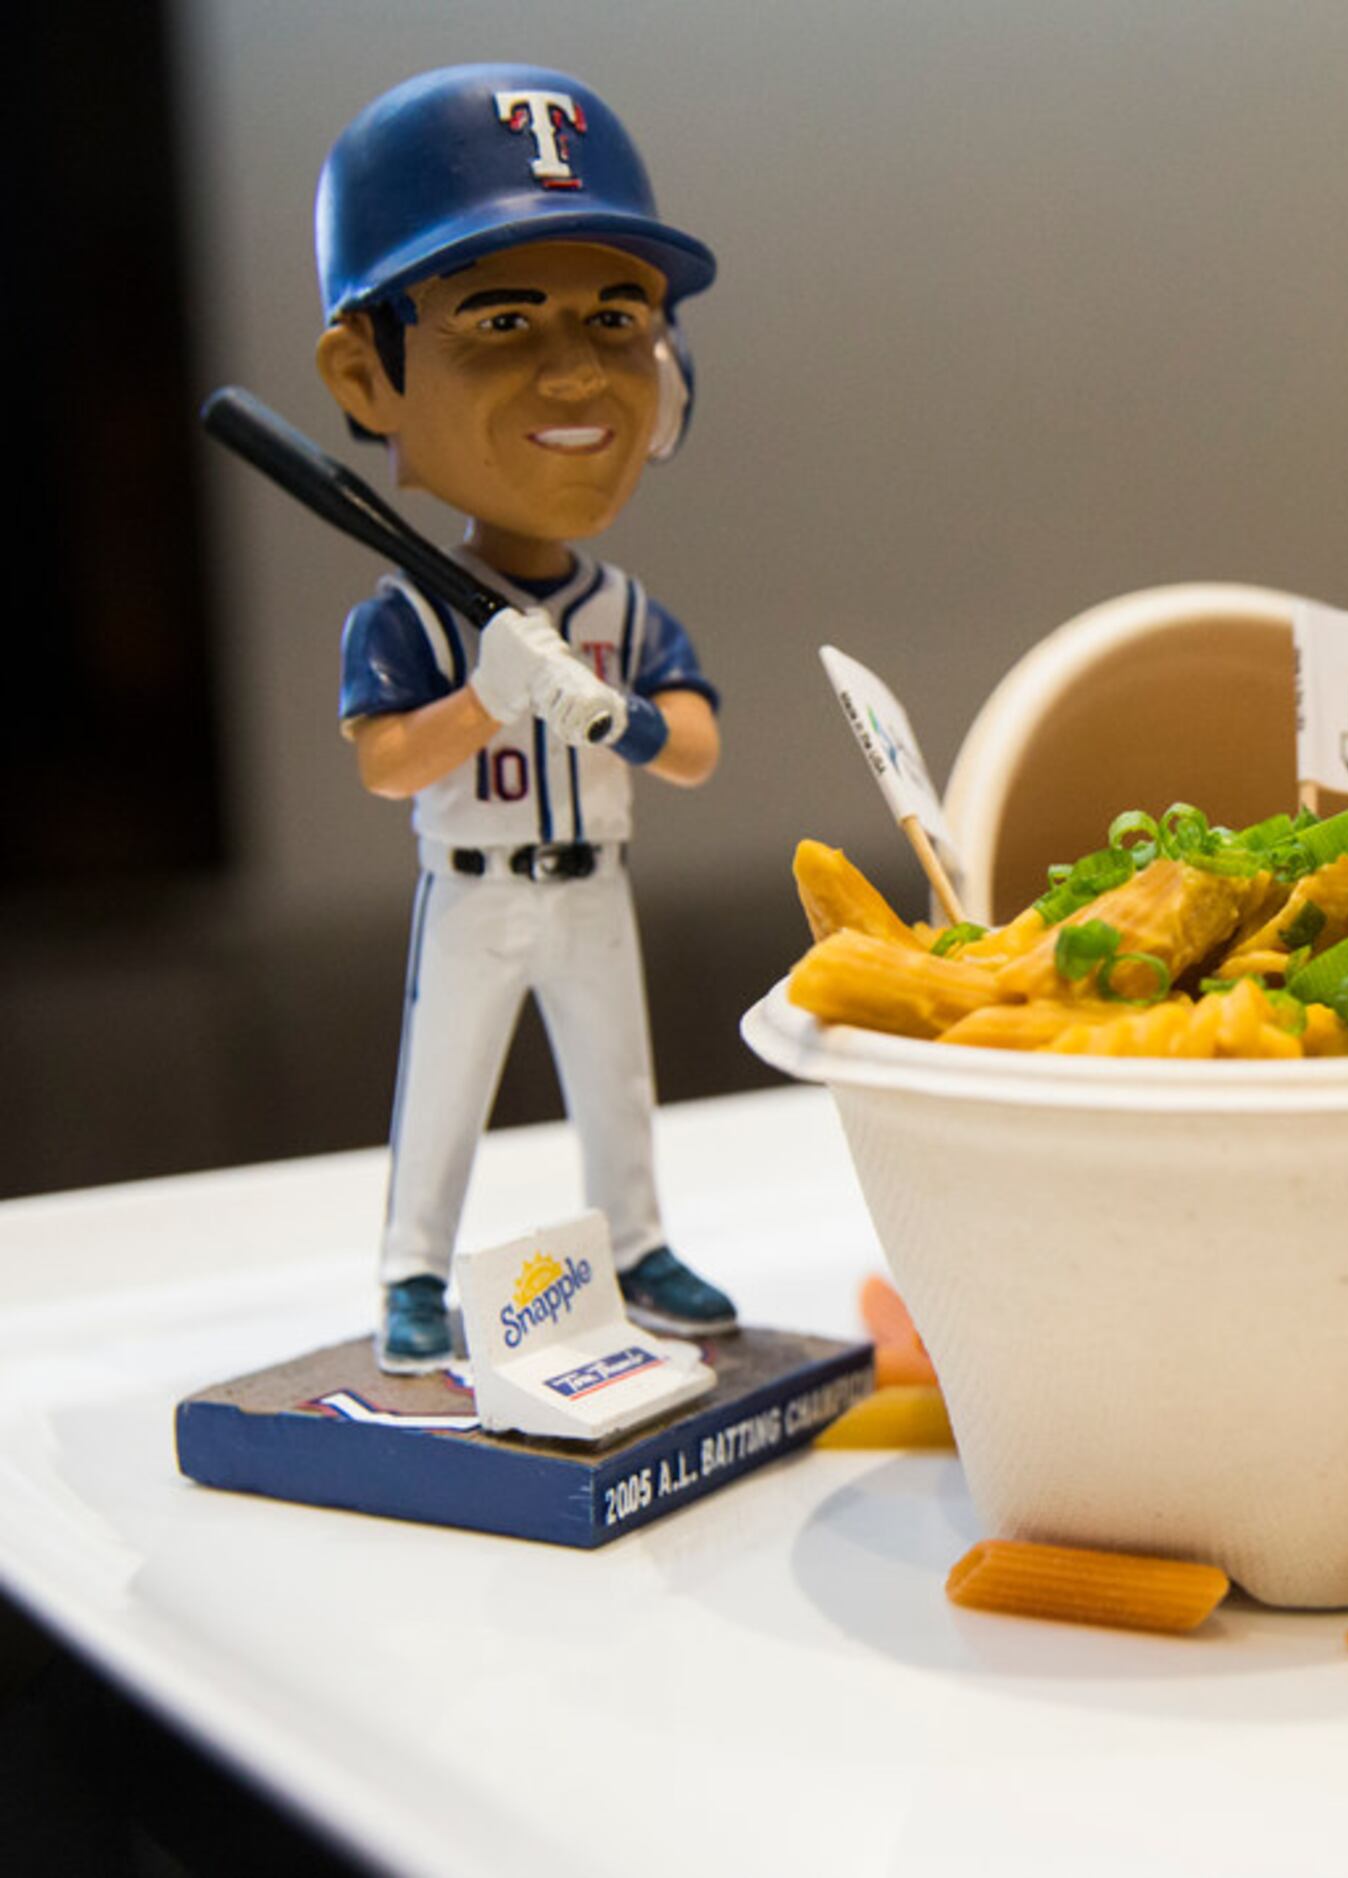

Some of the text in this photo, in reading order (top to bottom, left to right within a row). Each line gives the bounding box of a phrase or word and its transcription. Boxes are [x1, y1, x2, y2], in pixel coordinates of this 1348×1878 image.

[493, 90, 586, 189] T
[476, 746, 529, 802] 10
[500, 1257, 592, 1348] Snapple
[604, 1468, 652, 1526] 2005
[657, 1451, 698, 1497] A.L.
[701, 1405, 784, 1477] BATTING
